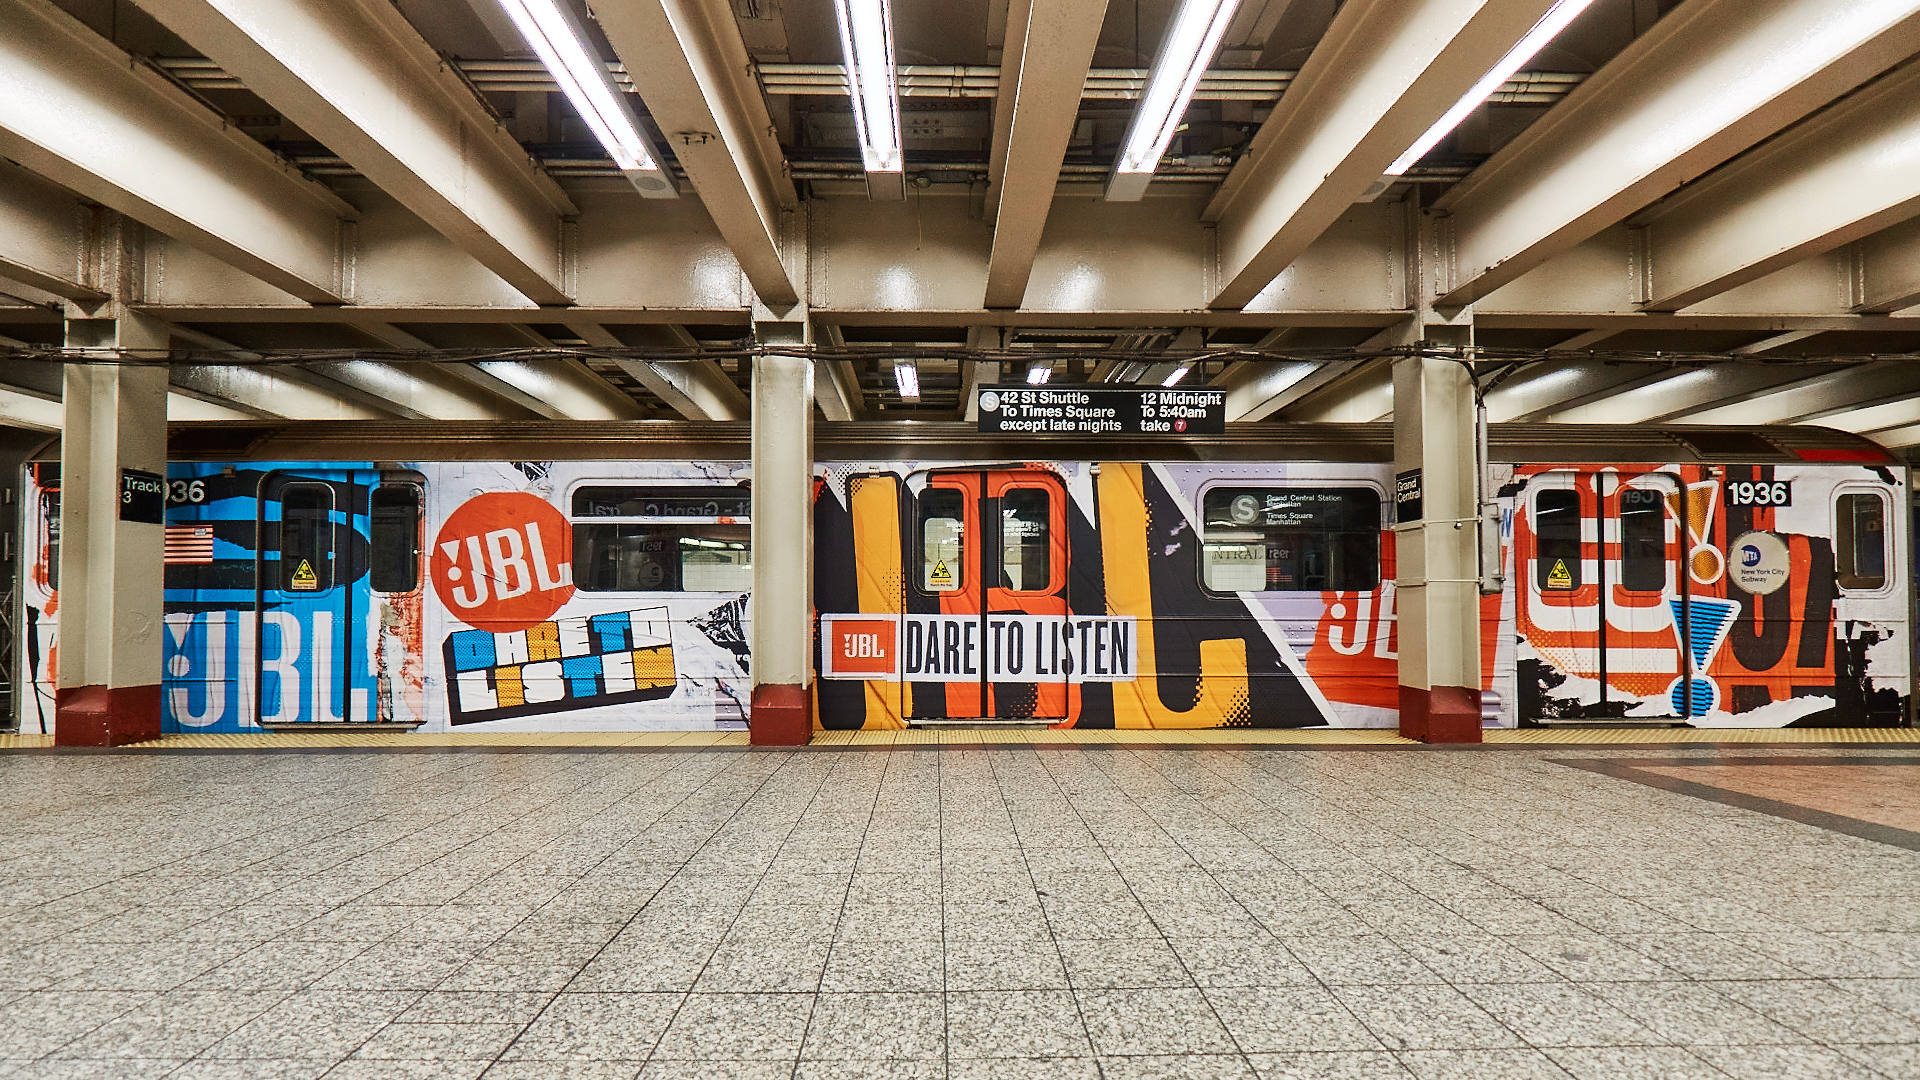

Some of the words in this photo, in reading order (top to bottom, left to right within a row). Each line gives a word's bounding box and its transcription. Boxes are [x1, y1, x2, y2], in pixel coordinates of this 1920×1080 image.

[1000, 391, 1022, 405] 42
[1023, 391, 1037, 405] St
[1038, 391, 1090, 405] Shuttle
[1141, 392, 1157, 405] 12
[1159, 392, 1222, 407] Midnight
[1000, 405, 1018, 418] To
[1020, 405, 1063, 418] Times
[1065, 405, 1116, 420] Square
[1141, 405, 1156, 418] To
[1159, 406, 1207, 418] 5:40am
[1000, 419, 1047, 433] except
[1050, 418, 1076, 431] late
[1078, 418, 1122, 433] nights
[1140, 419, 1171, 432] take
[124, 476, 162, 493] Track
[1397, 479, 1418, 492] Grand
[122, 490, 132, 504] 3
[1317, 494, 1342, 502] Station
[1397, 488, 1421, 503] Central
[1728, 481, 1787, 505] 1936
[1236, 497, 1255, 521] S
[1289, 513, 1313, 521] Square
[440, 522, 572, 609] JBL
[1771, 568, 1785, 576] City
[452, 616, 592, 672] DARE
[591, 607, 673, 653] TO
[843, 632, 885, 659] JBL
[905, 620, 977, 675] DARE
[990, 620, 1024, 675] TO
[1035, 620, 1129, 675] LISTEN
[165, 610, 369, 728] JBL
[456, 646, 677, 713] LISTEN
